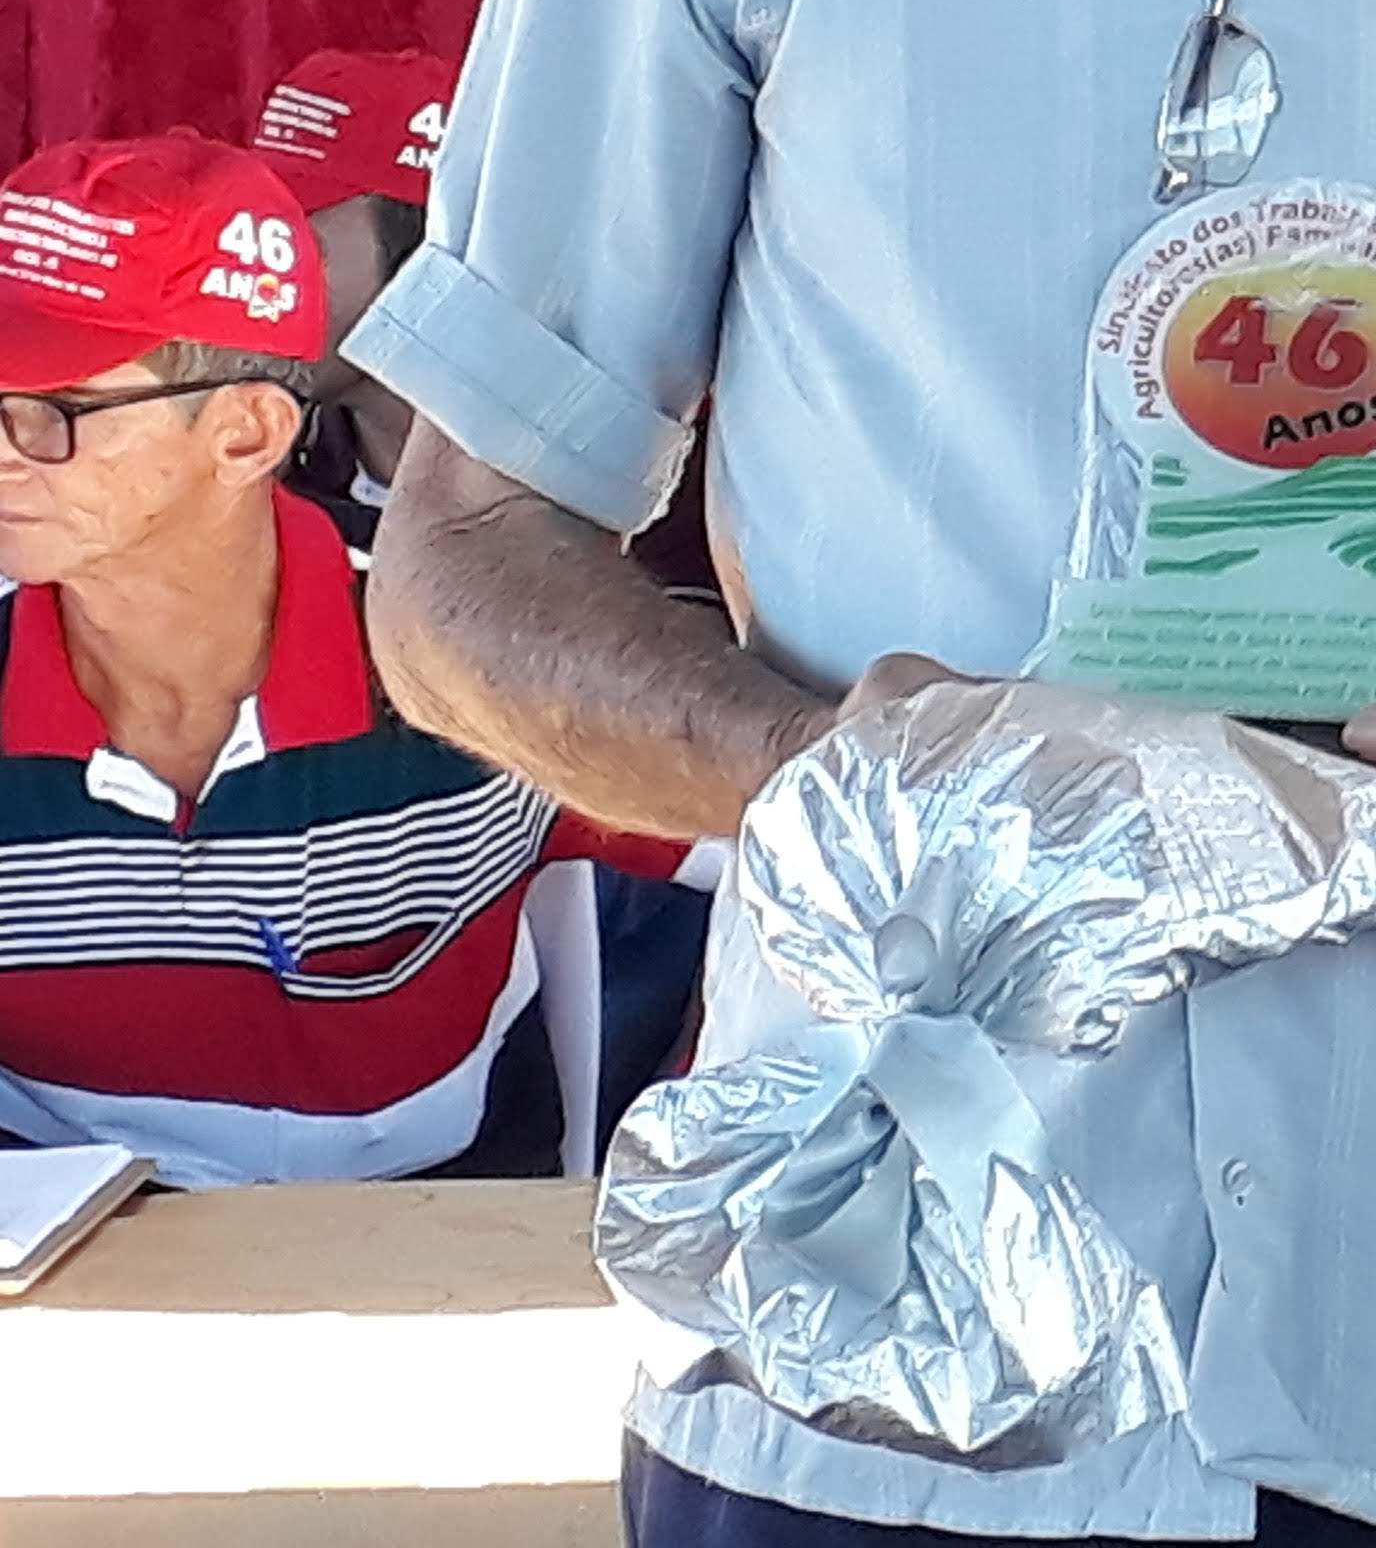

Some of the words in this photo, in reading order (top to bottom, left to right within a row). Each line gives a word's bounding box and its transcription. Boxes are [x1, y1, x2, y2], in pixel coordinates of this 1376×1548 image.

[408, 102, 448, 143] 4
[218, 211, 294, 272] 46
[1194, 295, 1368, 390] 46
